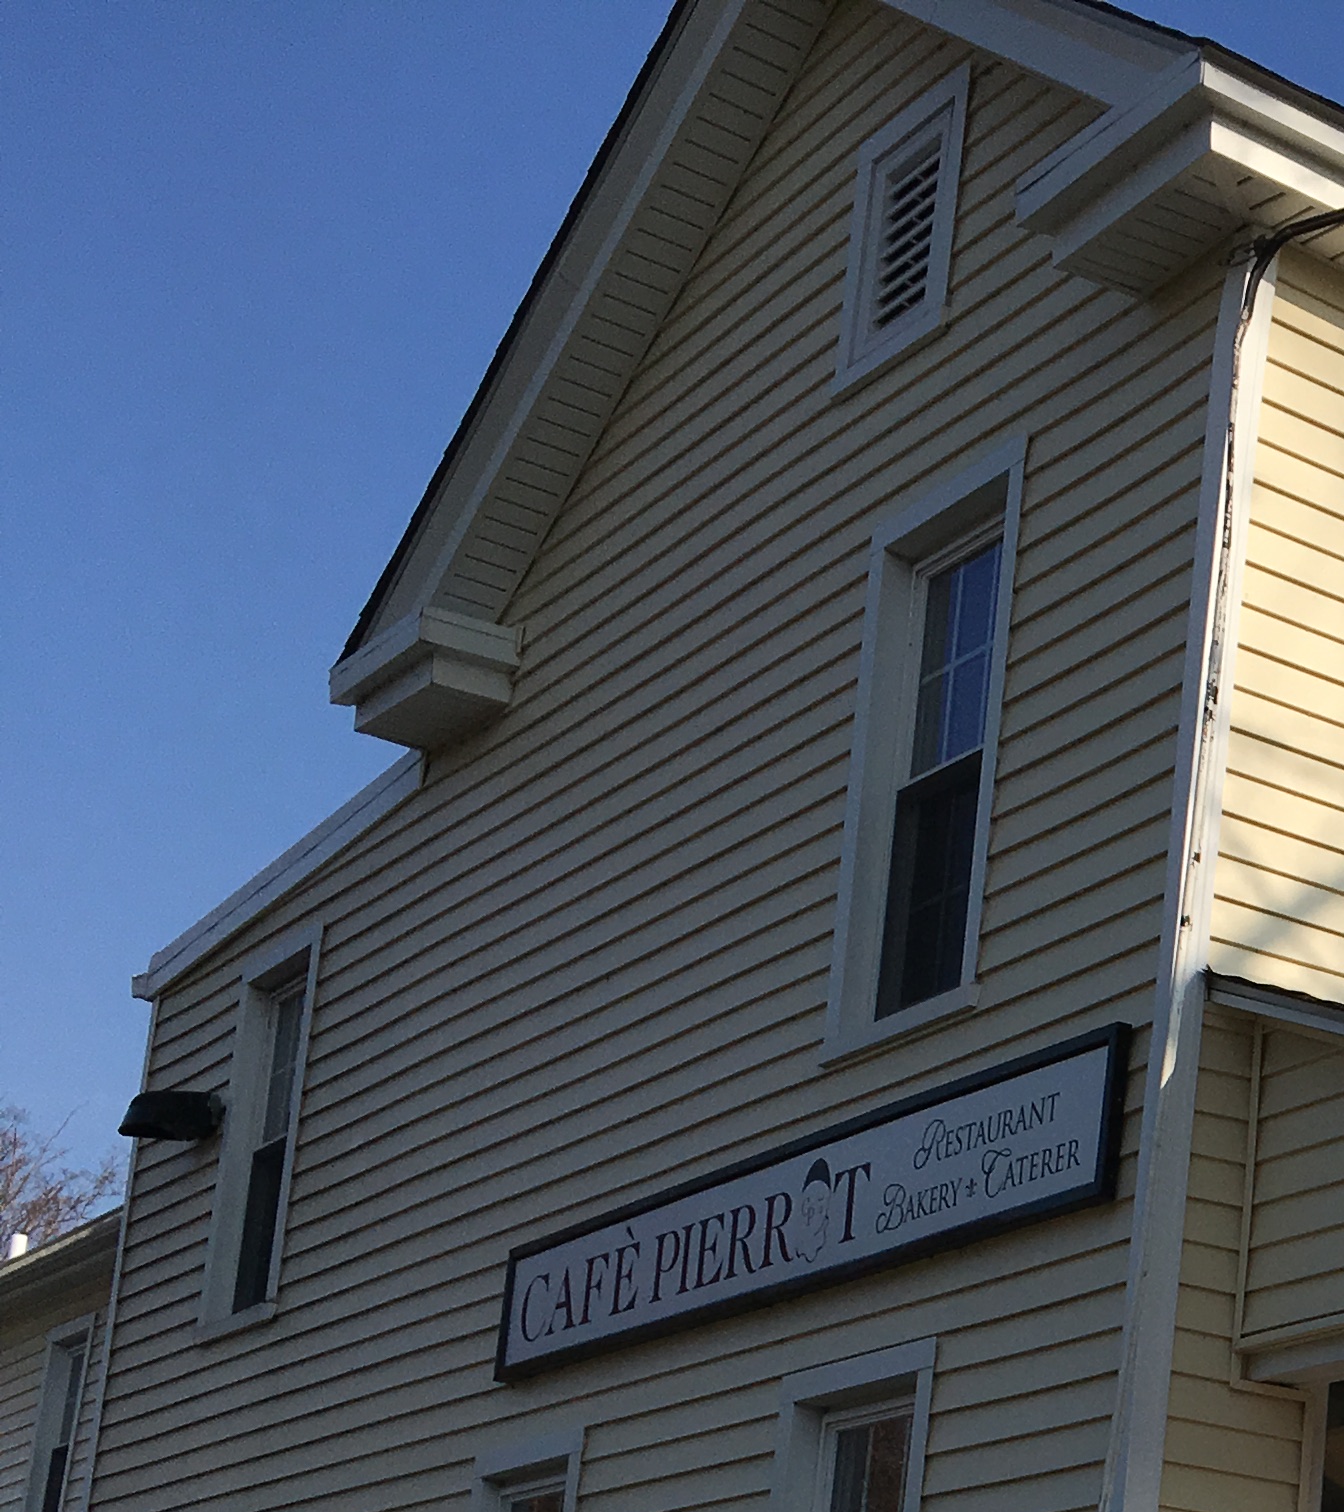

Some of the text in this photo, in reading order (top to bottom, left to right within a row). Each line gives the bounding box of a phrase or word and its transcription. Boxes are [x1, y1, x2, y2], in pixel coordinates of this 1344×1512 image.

[913, 1092, 1061, 1170] RESTAURANT
[875, 1138, 1081, 1235] BAKERY CATERER
[520, 1226, 641, 1343] CAFÈ
